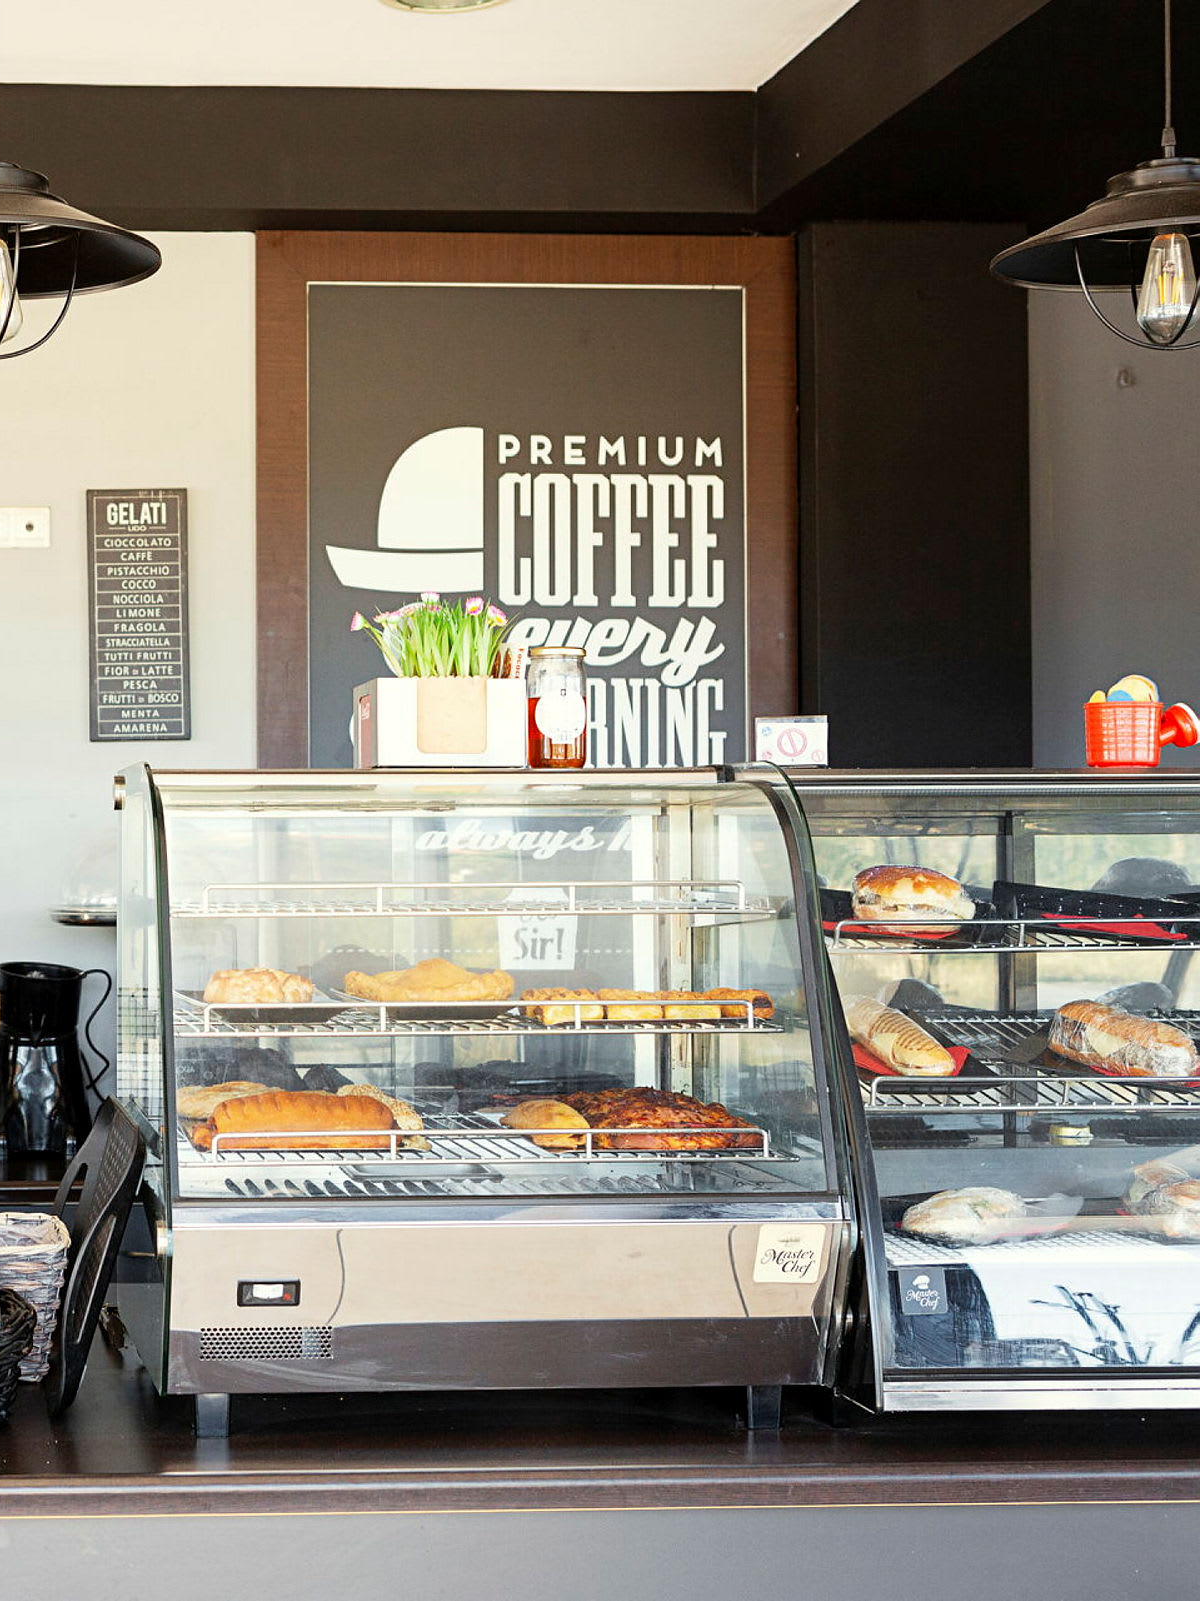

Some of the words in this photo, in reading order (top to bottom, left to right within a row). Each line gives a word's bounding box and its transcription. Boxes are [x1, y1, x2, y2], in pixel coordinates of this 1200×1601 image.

[498, 434, 723, 467] PREMIUM
[106, 502, 167, 526] GELATI
[104, 538, 172, 547] CIOCCOLATO
[498, 472, 725, 608] COFFEE
[120, 551, 153, 561] CAFFÈ
[107, 566, 170, 576] PISTACCHIO
[121, 579, 157, 590] COCCO
[112, 594, 164, 605] NOCCIOLA
[116, 608, 162, 618] LIMONE
[113, 622, 167, 632] FRAGOLA
[106, 638, 171, 647] STRACCIATELLA
[104, 652, 133, 661] TUTTI
[136, 651, 172, 661] FRUTTI
[506, 615, 726, 688] every
[104, 666, 130, 676] FIOR
[141, 666, 174, 675] LATTE
[122, 680, 158, 689] PESCA
[102, 694, 135, 704] FRUTTI
[147, 694, 179, 704] BOSCO
[121, 709, 160, 718] MENTA
[113, 723, 168, 733] AMARENA
[583, 677, 728, 769] RNING
[415, 818, 605, 860] always
[512, 927, 565, 962] Sir!
[760, 1248, 815, 1266] Master
[781, 1258, 816, 1278] Chef
[905, 1288, 939, 1302] Master
[919, 1295, 941, 1311] Chef
